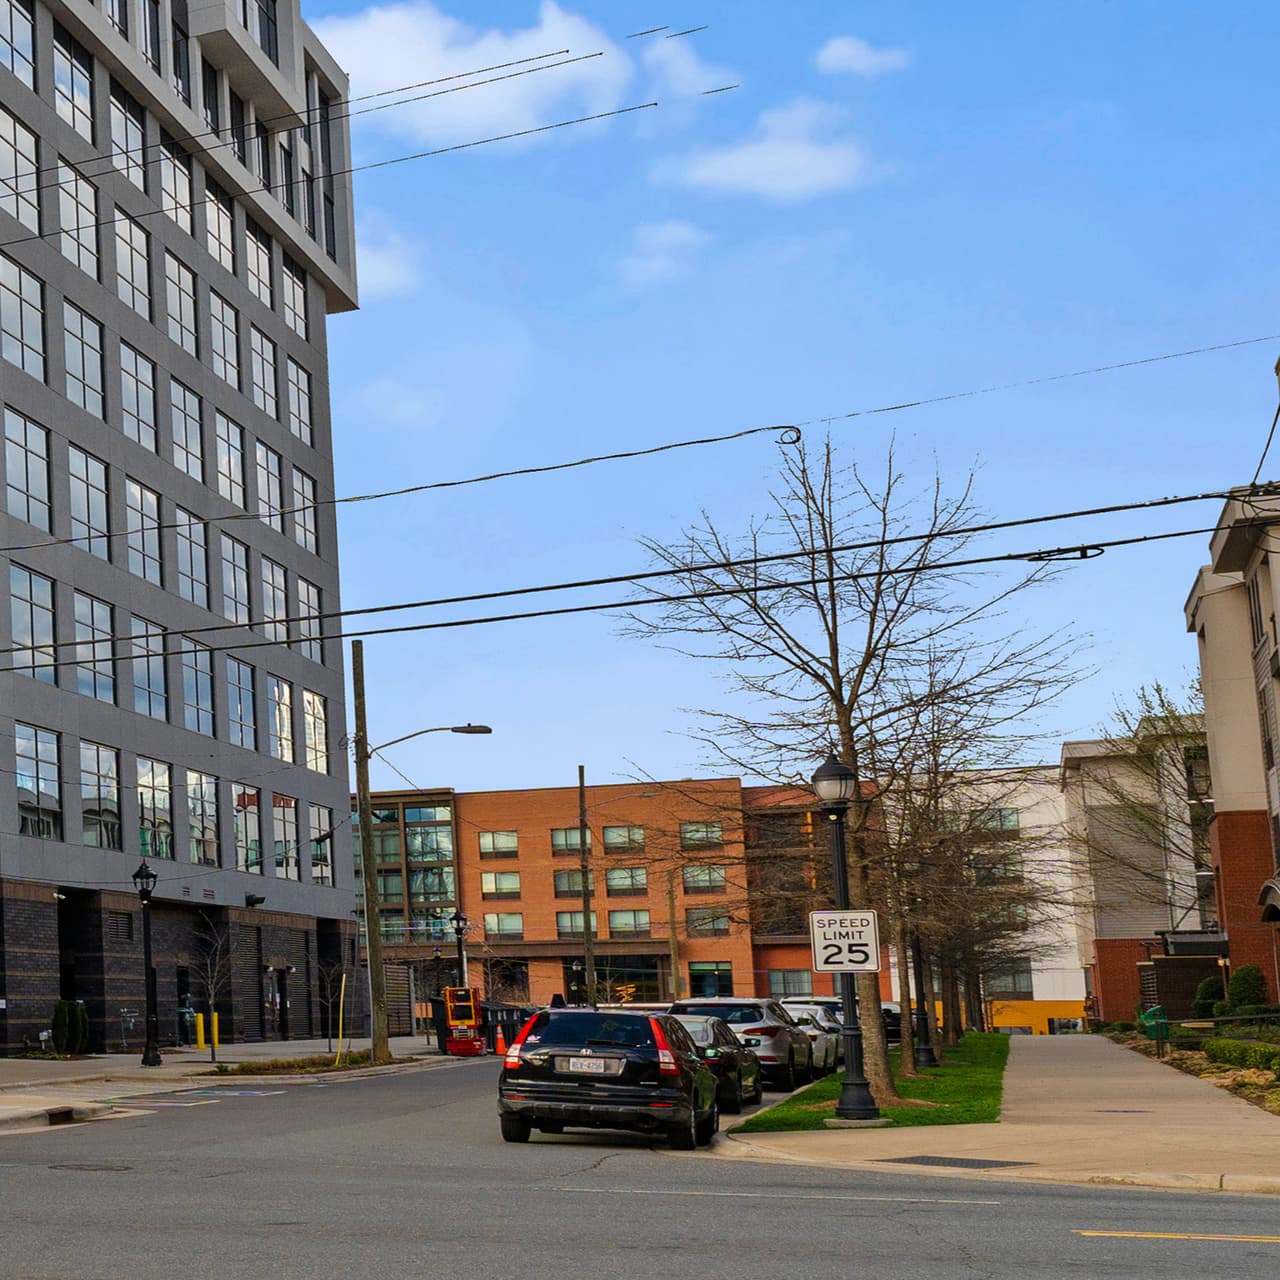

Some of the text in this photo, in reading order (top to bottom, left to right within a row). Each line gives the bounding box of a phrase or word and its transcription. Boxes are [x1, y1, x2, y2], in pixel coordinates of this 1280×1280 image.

[816, 918, 870, 928] SPEED
[823, 930, 865, 940] LIMIT
[822, 943, 870, 965] 25
